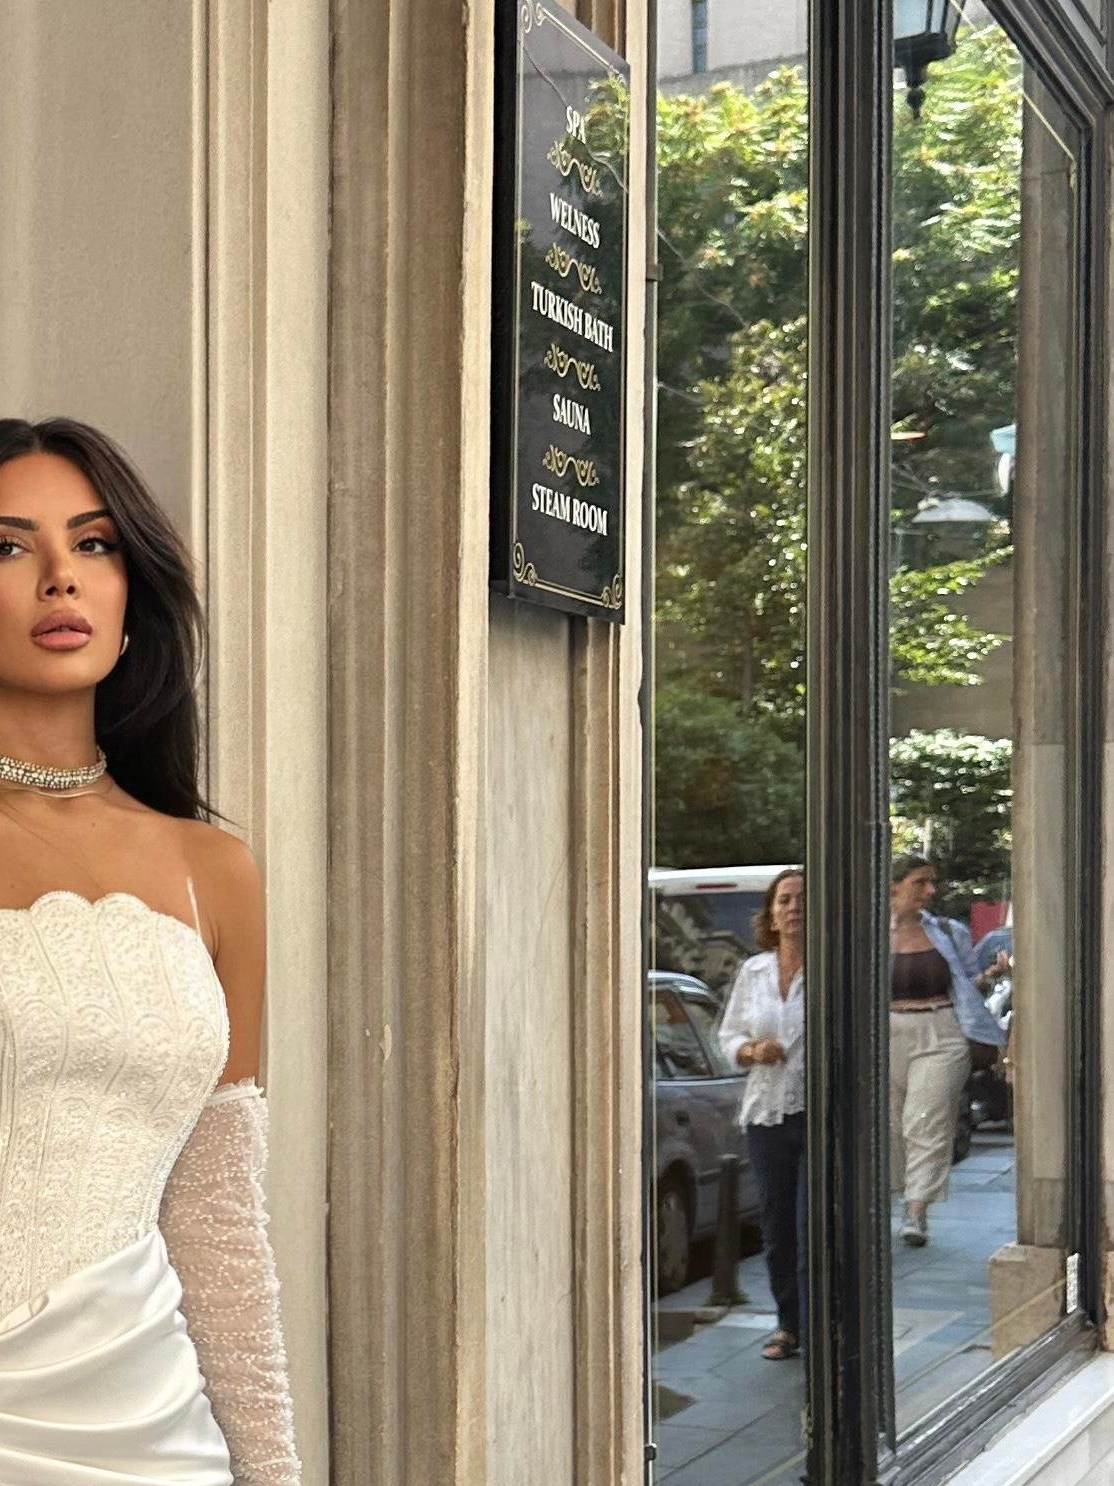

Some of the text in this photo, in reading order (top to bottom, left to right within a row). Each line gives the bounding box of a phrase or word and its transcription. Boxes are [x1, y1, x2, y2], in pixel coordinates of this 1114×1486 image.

[566, 105, 587, 144] SPA
[549, 192, 601, 249] WELNESS
[530, 281, 614, 353] TURKISH BATH
[552, 393, 591, 435] SAUNA
[531, 482, 608, 537] STEAM ROOM
